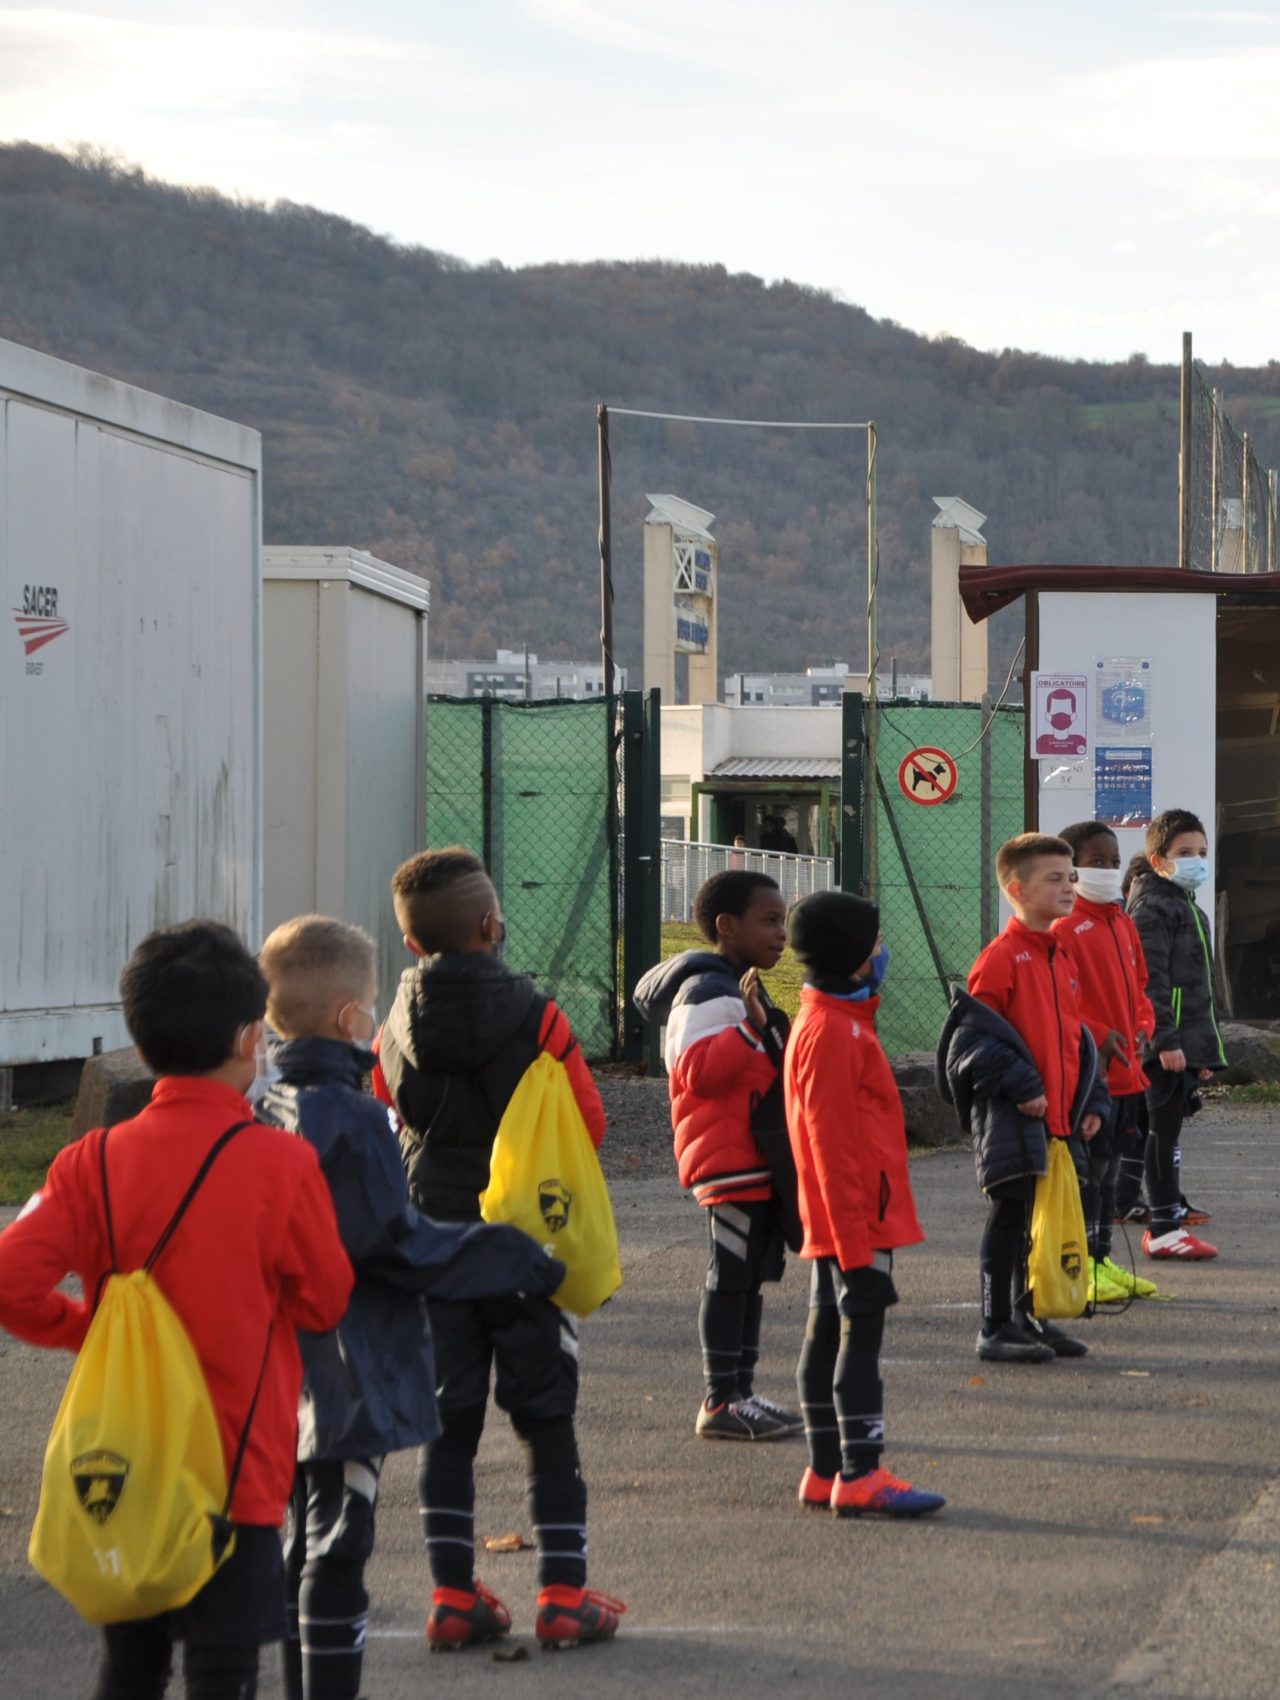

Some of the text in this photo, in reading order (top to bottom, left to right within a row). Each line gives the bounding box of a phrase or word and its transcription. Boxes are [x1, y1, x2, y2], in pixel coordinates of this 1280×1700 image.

[23, 584, 58, 617] SACER
[1038, 680, 1087, 688] OBLIGATOIRE
[92, 1547, 119, 1577] 11
